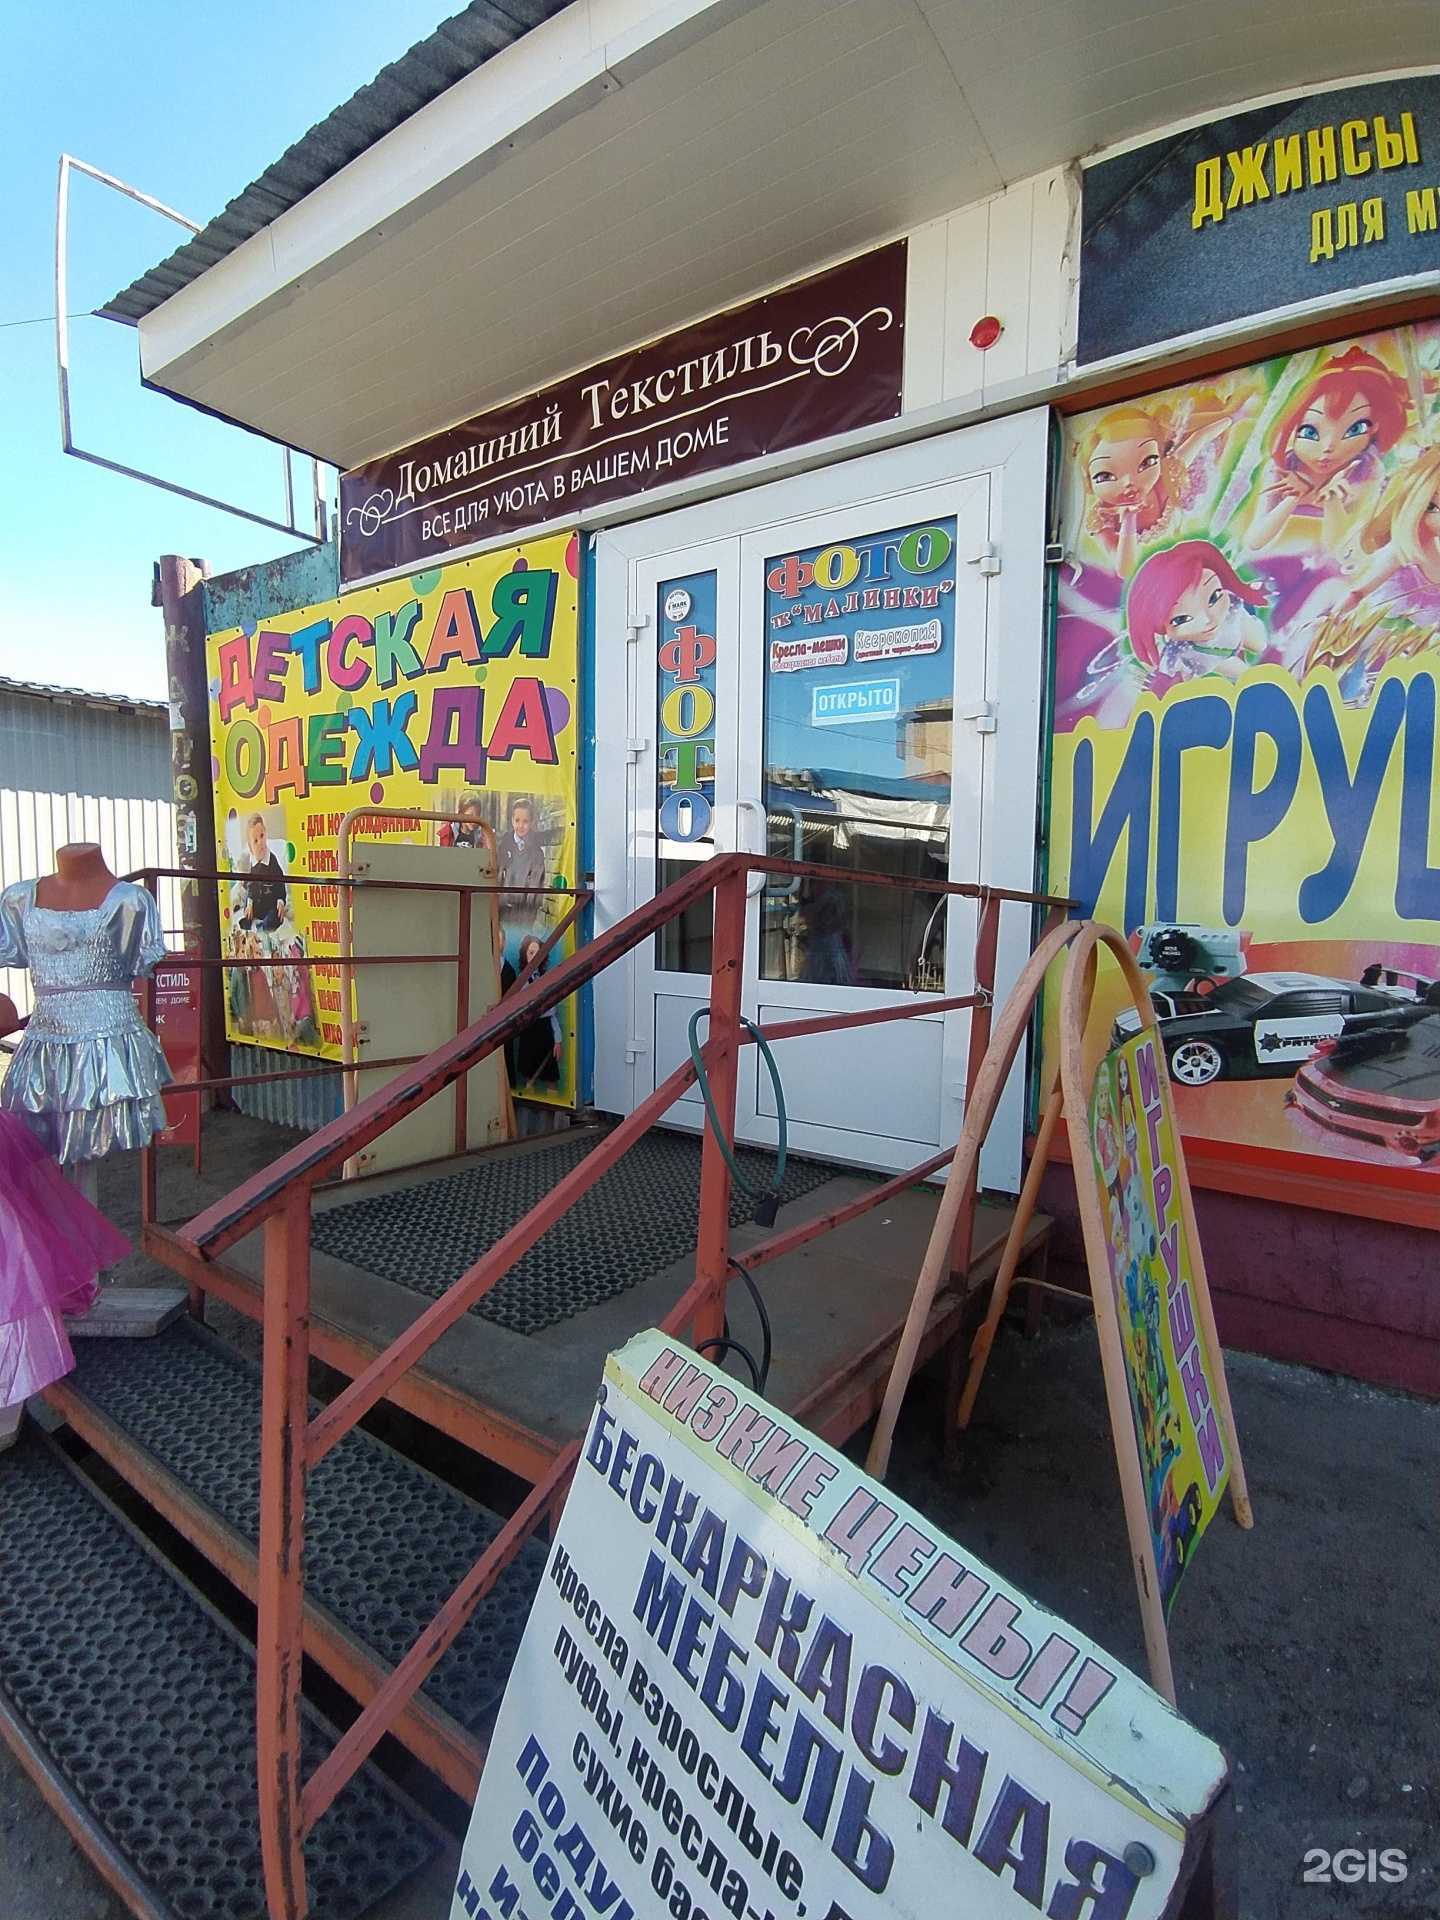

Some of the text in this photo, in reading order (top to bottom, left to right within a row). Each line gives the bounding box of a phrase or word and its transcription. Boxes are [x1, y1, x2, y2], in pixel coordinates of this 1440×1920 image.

[1192, 112, 1420, 229] ДЖИНСЫ
[1310, 188, 1440, 262] ДЛЯ М
[395, 330, 783, 510] Домашний Текстиль
[422, 416, 730, 541] ВСЕ ДЛЯ УЮТА В ВАШЕМ ДОМЕ
[218, 568, 559, 723] ДЕТСКАЯ
[767, 527, 952, 599] ФОТО
[225, 677, 559, 805] ОДЕЖДА
[658, 624, 717, 844] ФОТО
[818, 687, 894, 712] ОТКРЫТО
[1136, 1042, 1227, 1496] ИГРУШКИ
[638, 1347, 1118, 1736] НИЗКИЕ ЦЕНЫ!
[550, 1544, 807, 1917] кресла взрослые,
[585, 1409, 1141, 1920] БЕСКАРКАСНАЯ
[633, 1550, 895, 1894] МЕБЕЛЬ
[553, 1624, 776, 1920] пуфы, кресла-
[573, 1731, 649, 1865] сухие
